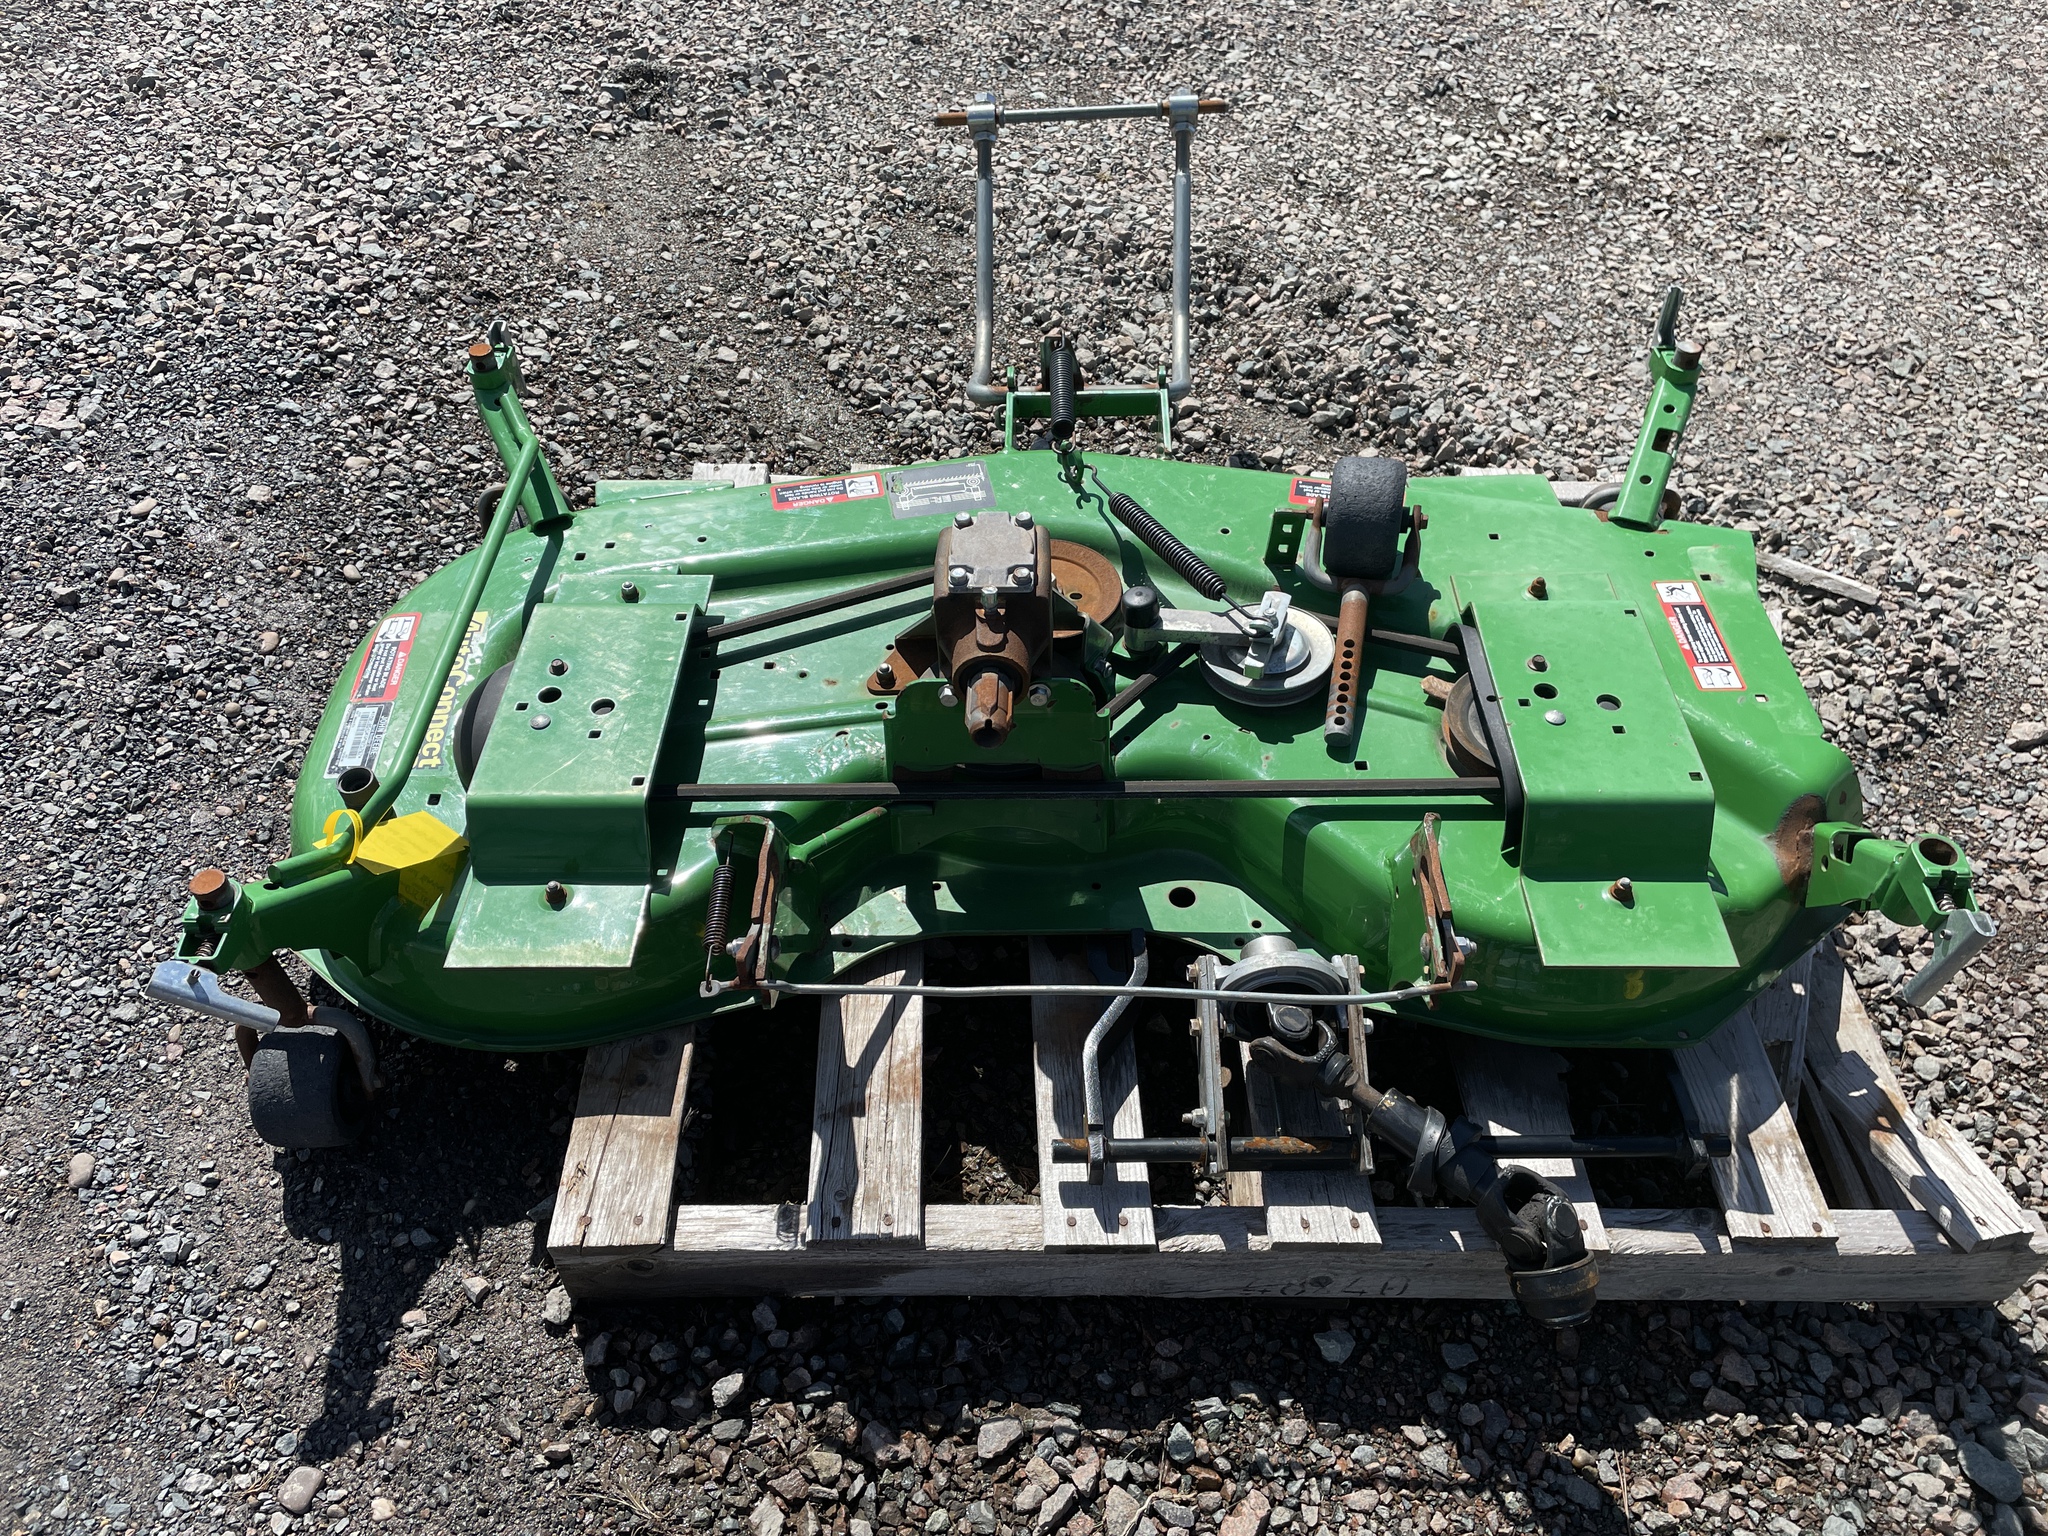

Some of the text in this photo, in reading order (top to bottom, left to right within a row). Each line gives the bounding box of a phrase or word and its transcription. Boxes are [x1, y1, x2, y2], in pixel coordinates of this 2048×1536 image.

[792, 498, 826, 507] DANGER
[809, 490, 840, 498] ROTATING
[1668, 616, 1687, 647] DANGER
[378, 646, 397, 688] ROTATING BLADE
[389, 658, 404, 685] DANGER
[376, 715, 388, 732] JOHN
[369, 734, 382, 755] DEERE
